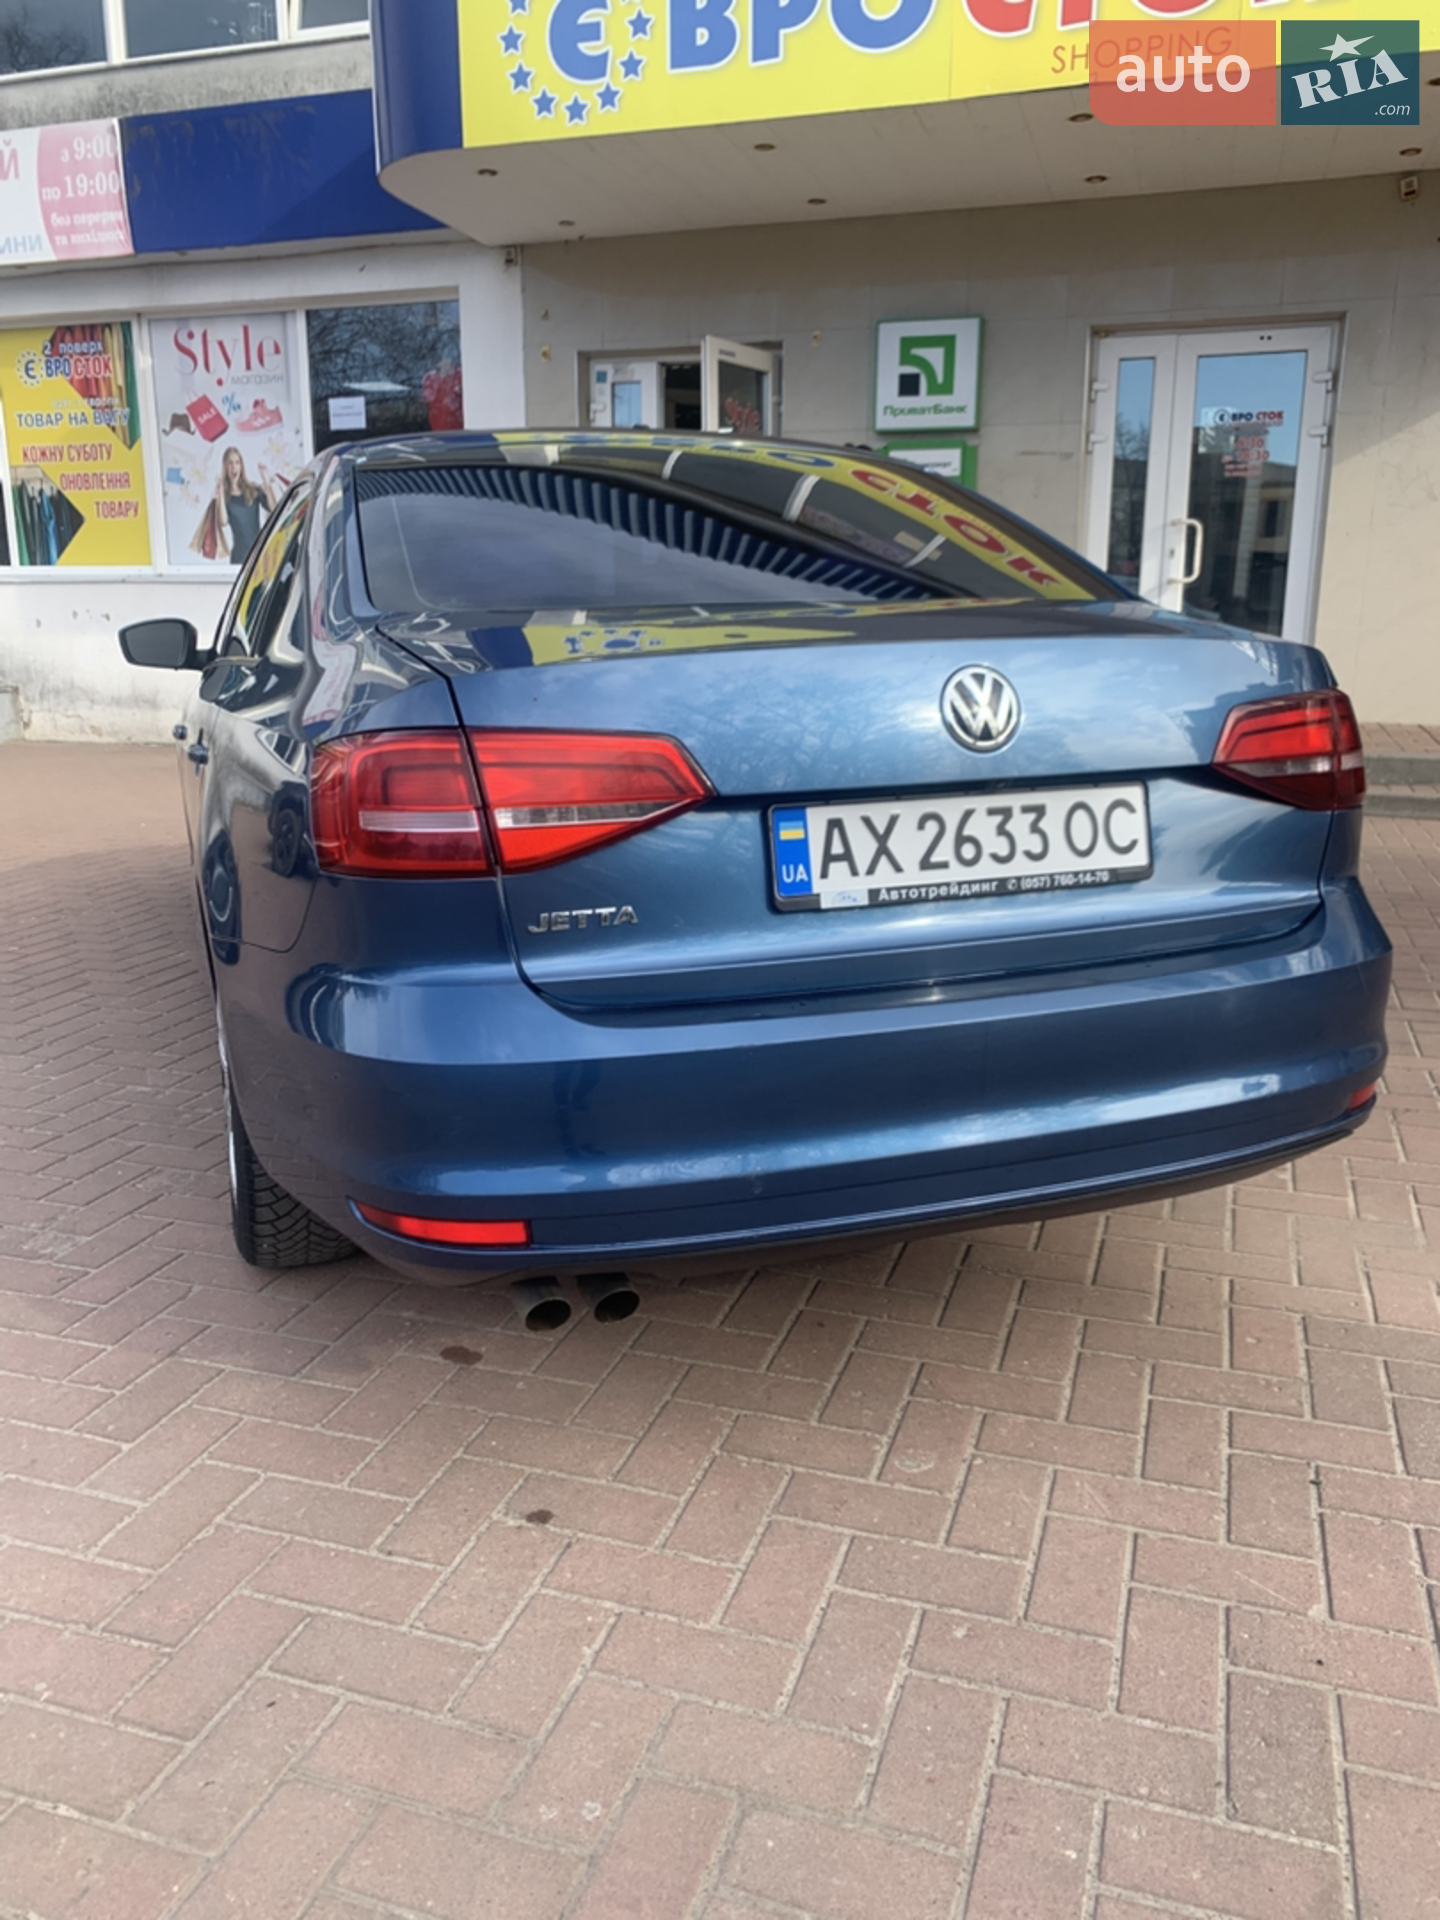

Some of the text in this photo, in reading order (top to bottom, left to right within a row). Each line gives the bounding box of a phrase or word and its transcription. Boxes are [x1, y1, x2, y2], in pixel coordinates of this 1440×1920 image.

[42, 170, 121, 200] по 19:00
[43, 341, 104, 357] 2 поверх
[173, 324, 281, 387] Style
[231, 374, 284, 386] магазин
[16, 408, 130, 428] ТОВАР НА ВАГУ
[197, 407, 217, 425] SALE
[883, 403, 968, 419] ПриватБанк
[22, 443, 112, 463] КОЖНУ СУБОТУ
[60, 471, 131, 491] ОНОВЛЕННЯ
[94, 500, 139, 518] ТОВАРУ
[820, 798, 1140, 880] AX 2633 OC
[781, 864, 809, 883] UA
[878, 881, 998, 902] Автотрейдинг
[1020, 873, 1050, 890] (057)
[1053, 870, 1110, 887] 760-14-70
[528, 905, 638, 932] JETTA
